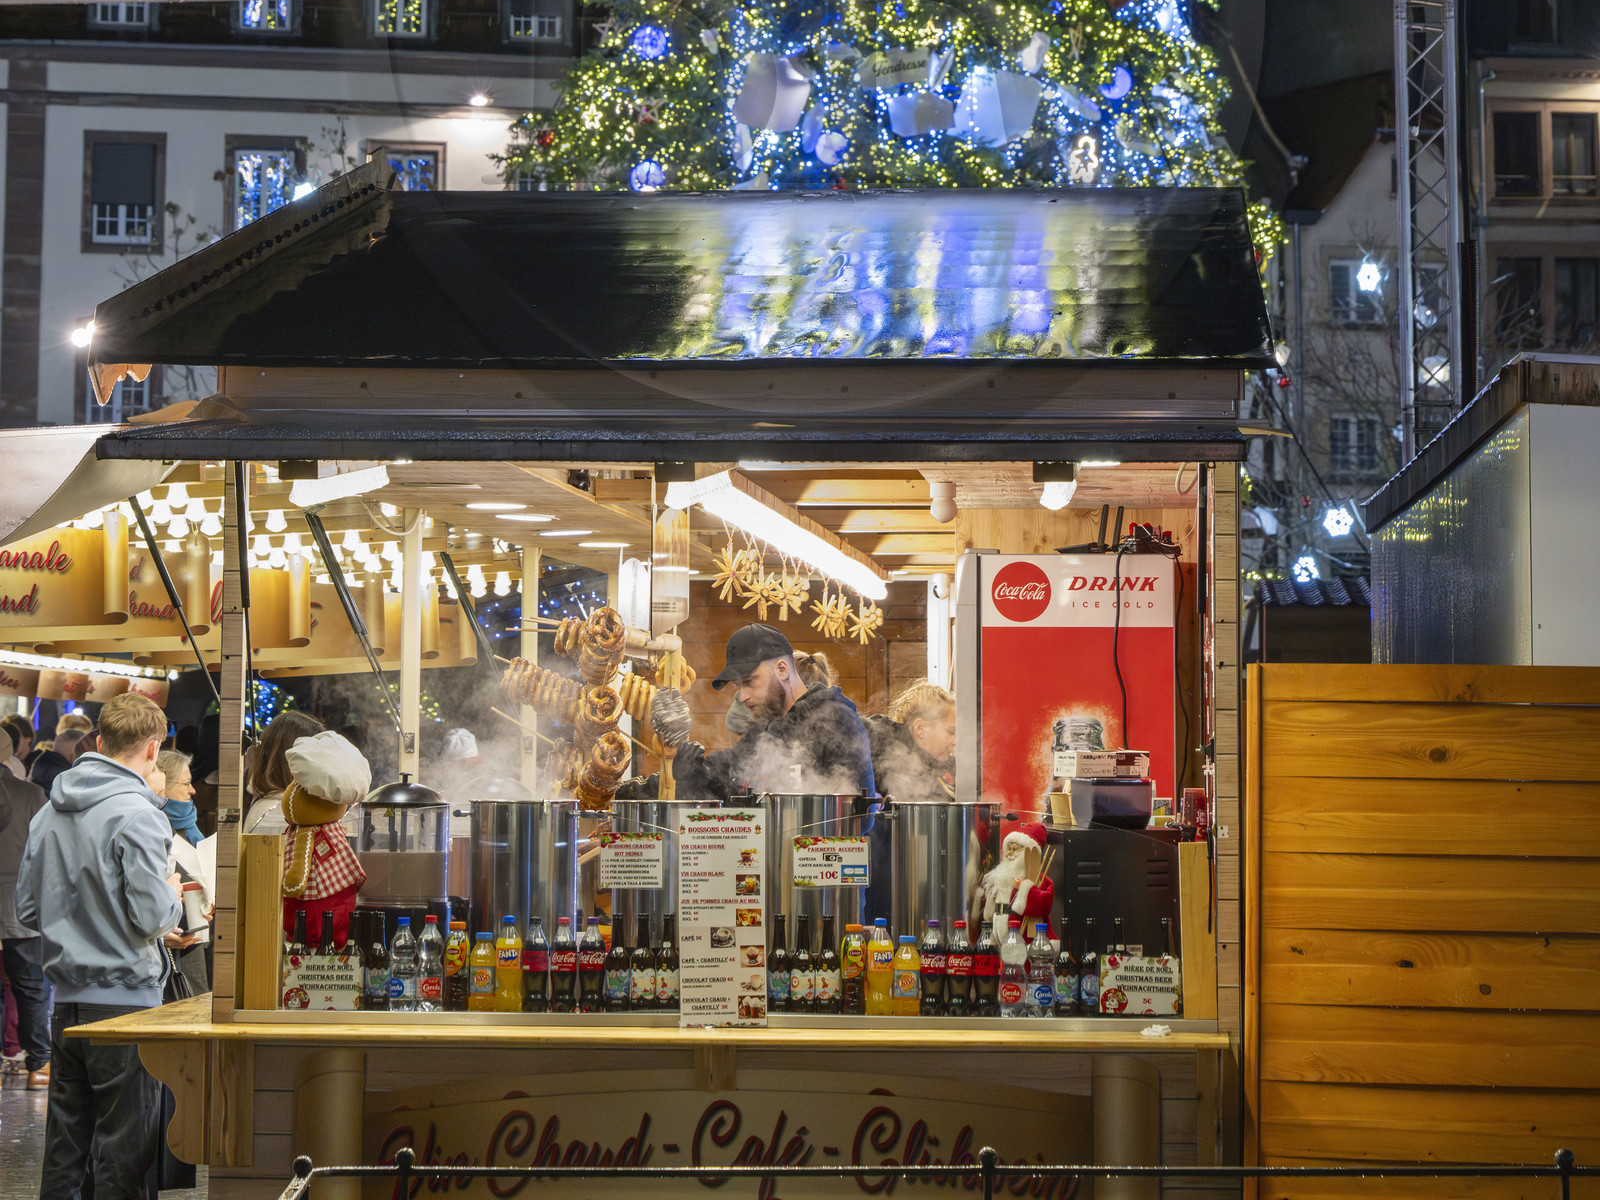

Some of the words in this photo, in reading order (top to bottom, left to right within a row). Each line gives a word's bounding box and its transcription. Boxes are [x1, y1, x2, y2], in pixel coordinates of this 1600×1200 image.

[872, 59, 927, 77] Tendresse
[995, 582, 1048, 601] Coca-Cola
[1067, 576, 1159, 592] DRINK
[1072, 601, 1101, 609] ICE
[1112, 601, 1154, 609] COLD
[820, 870, 838, 880] 10€
[498, 948, 519, 959] FANTA
[305, 963, 326, 971] BIÈRE
[336, 963, 354, 971] NOËL
[1124, 965, 1144, 973] BIÈRE
[1156, 965, 1173, 974] NOËL
[299, 983, 357, 991] WEIHNACHTSBIER
[422, 983, 441, 991] Carola
[897, 977, 916, 988] Oasis
[1001, 988, 1020, 998] Carola
[1117, 984, 1176, 993] WEIHNACHTSBIER
[1034, 989, 1053, 999] Carola
[485, 1109, 653, 1198] Chaud
